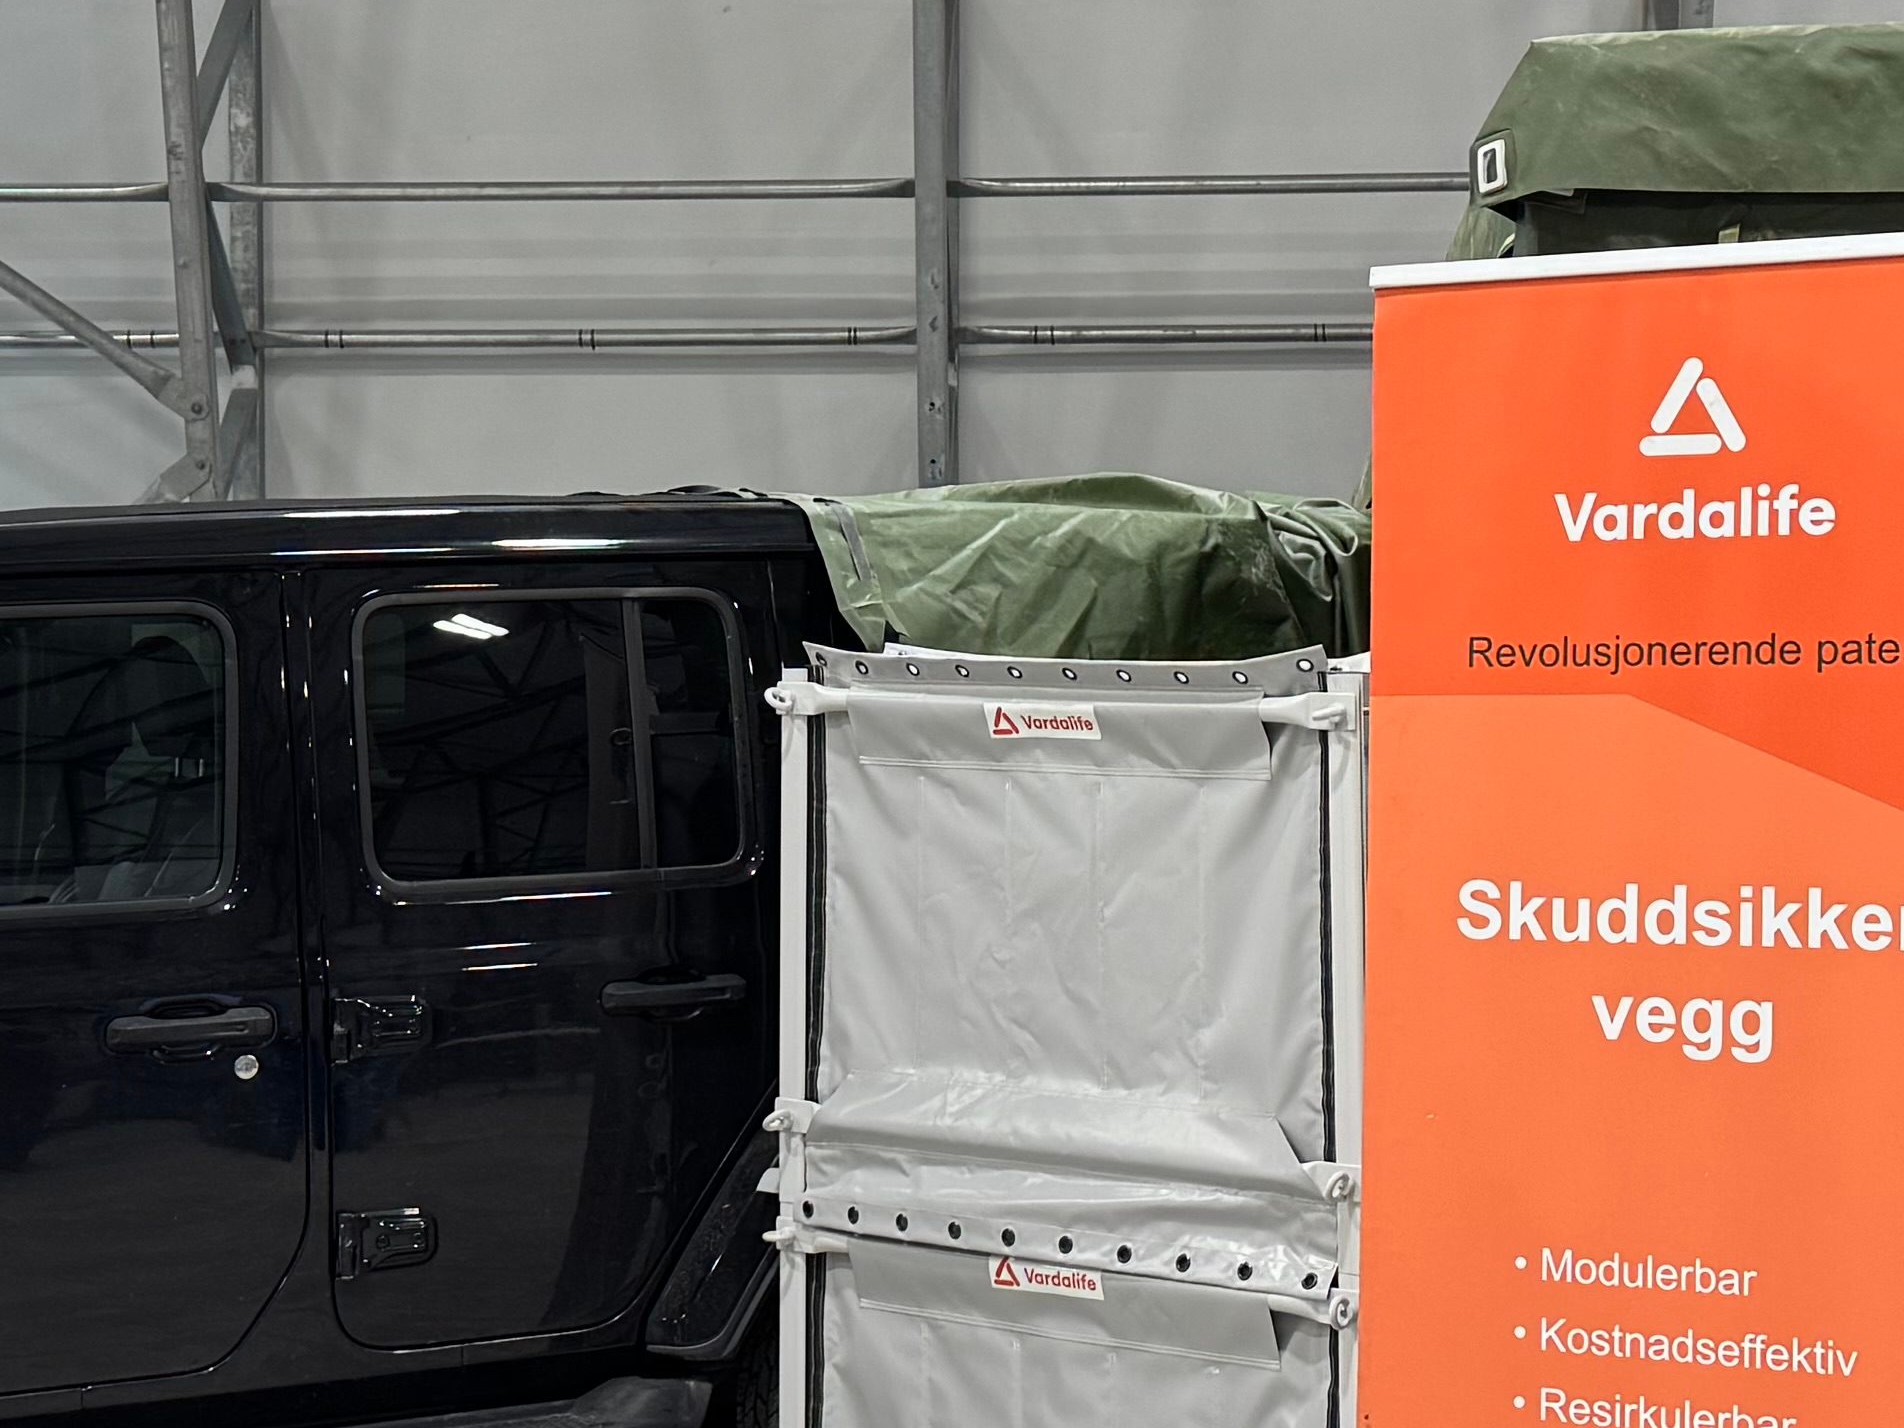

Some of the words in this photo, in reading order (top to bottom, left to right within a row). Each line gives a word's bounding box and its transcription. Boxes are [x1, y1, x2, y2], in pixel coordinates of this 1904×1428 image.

[1554, 483, 1836, 542] Vardalife
[1468, 632, 1802, 675] Revolusjonerende
[1020, 714, 1094, 731] Vardalife
[1591, 994, 1775, 1065] vegg
[1024, 1267, 1097, 1291] Vardalife
[1540, 1246, 1759, 1297] Modulerbar
[1540, 1317, 1859, 1377] Kostnadseffektiv
